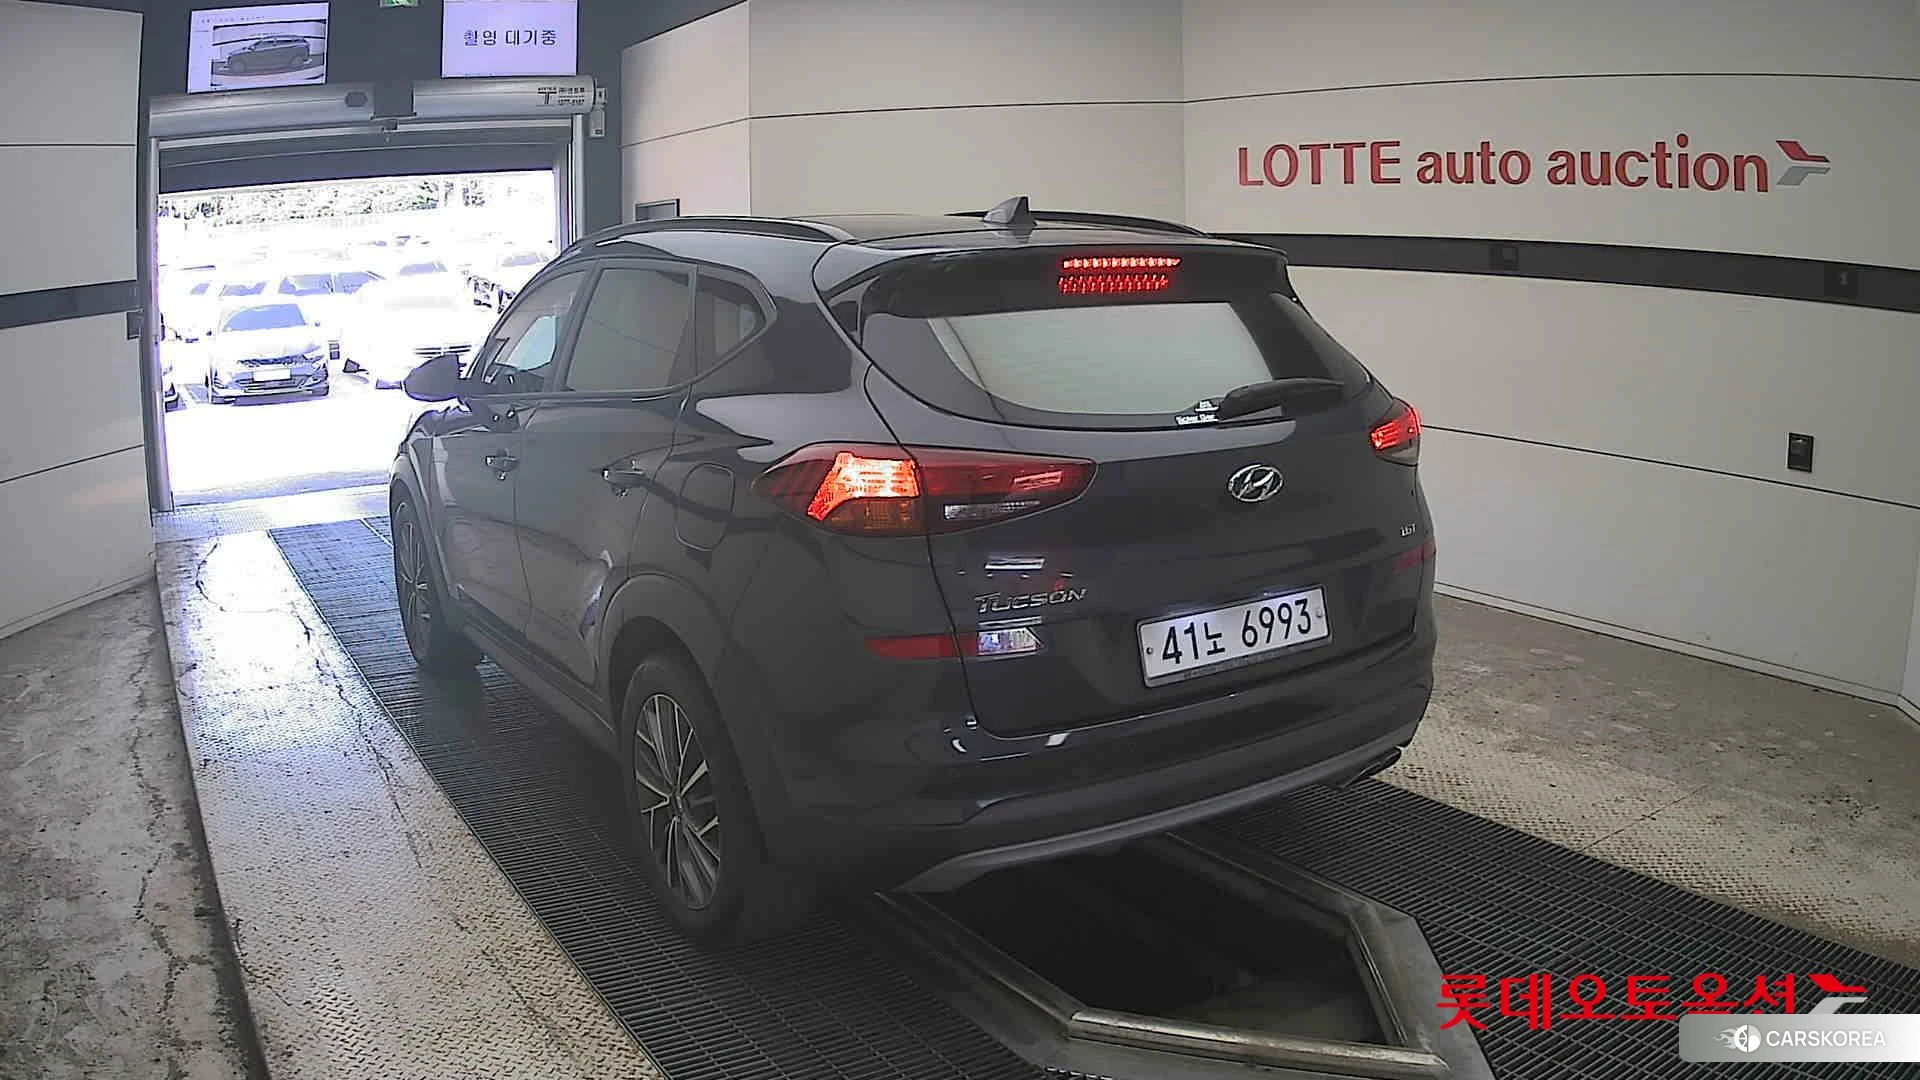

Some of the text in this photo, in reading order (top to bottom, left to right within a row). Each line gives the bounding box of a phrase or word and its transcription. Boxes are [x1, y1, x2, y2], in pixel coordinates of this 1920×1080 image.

[504, 29, 556, 46] 대기중
[1238, 133, 1769, 193] LOTTE auto auction
[974, 588, 1087, 614] TUCSON
[1161, 621, 1226, 665] 41노
[1241, 598, 1312, 648] 6993
